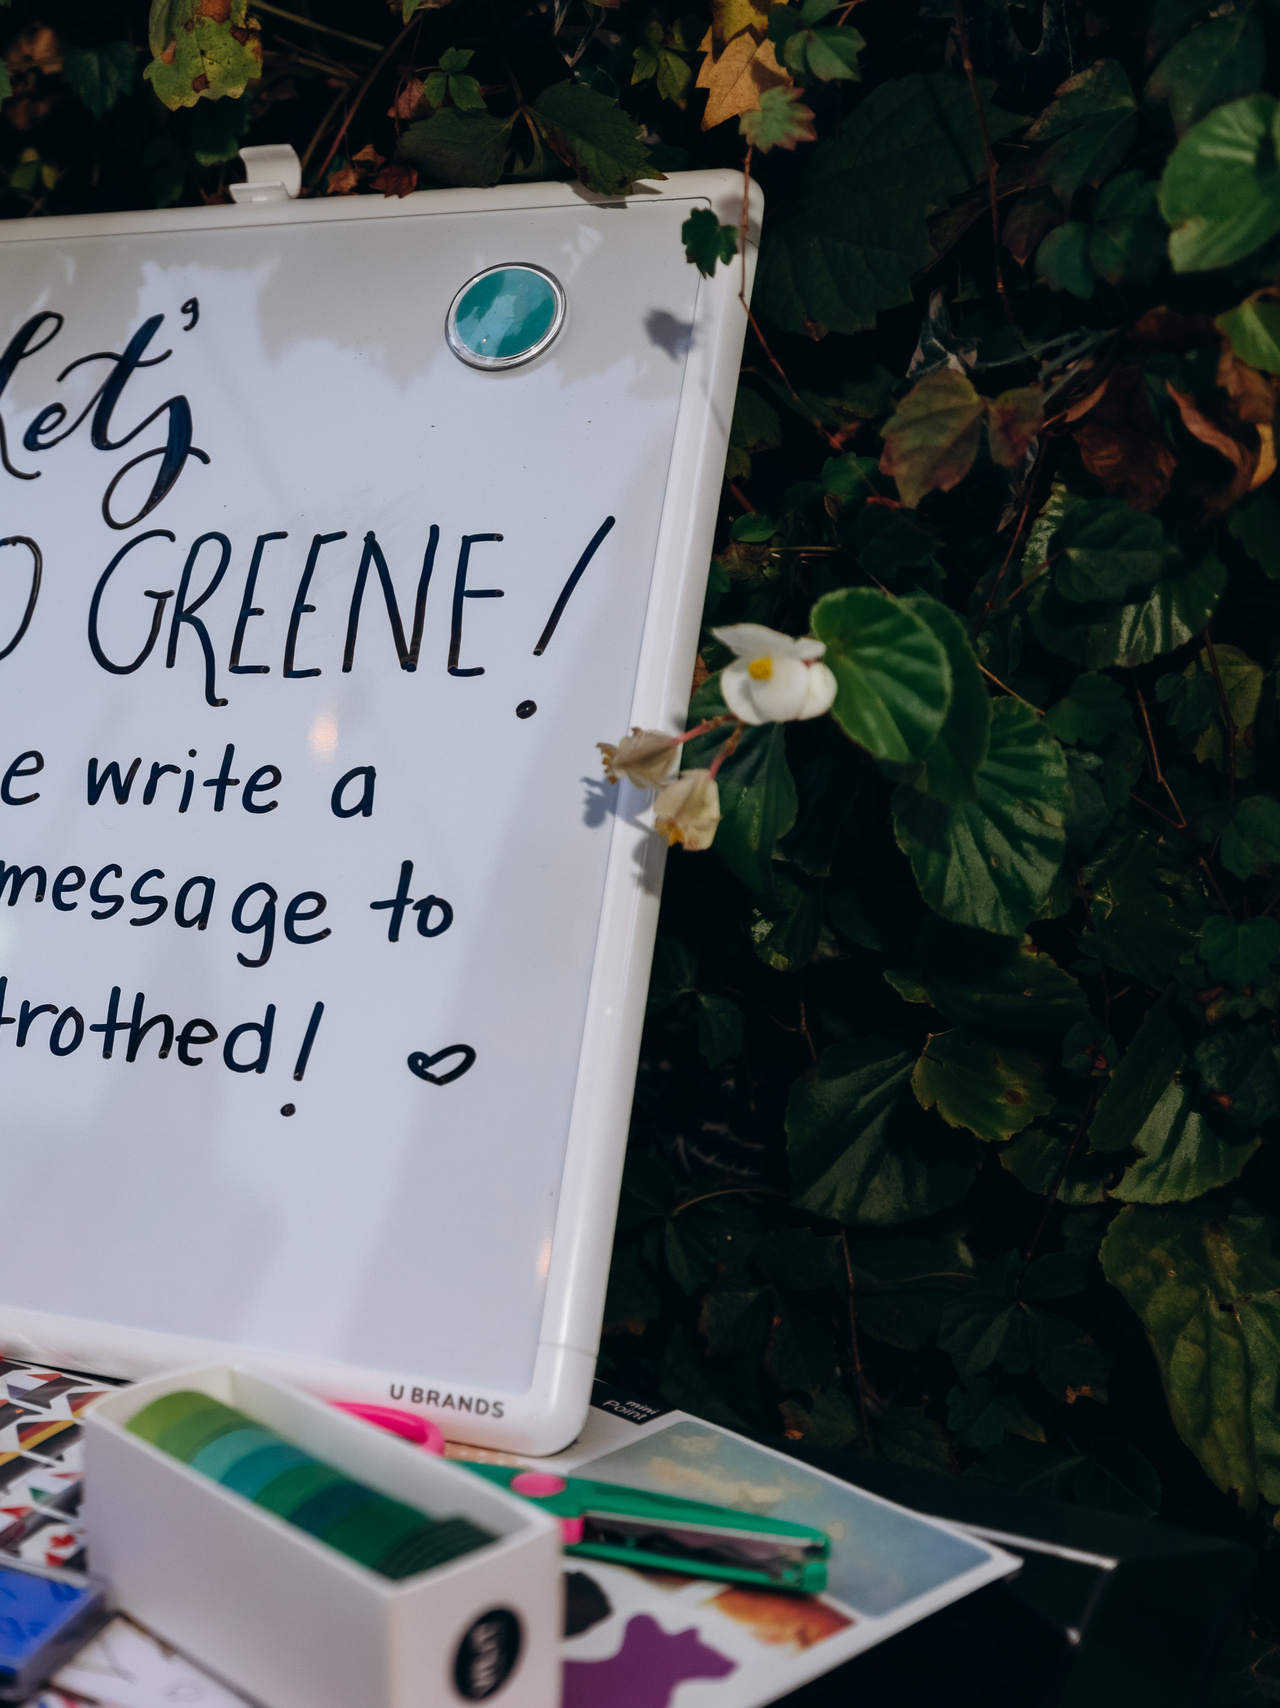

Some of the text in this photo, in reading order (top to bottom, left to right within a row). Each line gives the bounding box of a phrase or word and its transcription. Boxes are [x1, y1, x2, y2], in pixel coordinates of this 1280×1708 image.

[87, 515, 616, 720] GREENE!
[87, 743, 282, 814] write
[330, 765, 377, 819] a
[369, 859, 454, 943] to
[390, 1384, 505, 1418] U BRANDS
[602, 1400, 647, 1420] Point
[626, 1401, 660, 1415] mini
